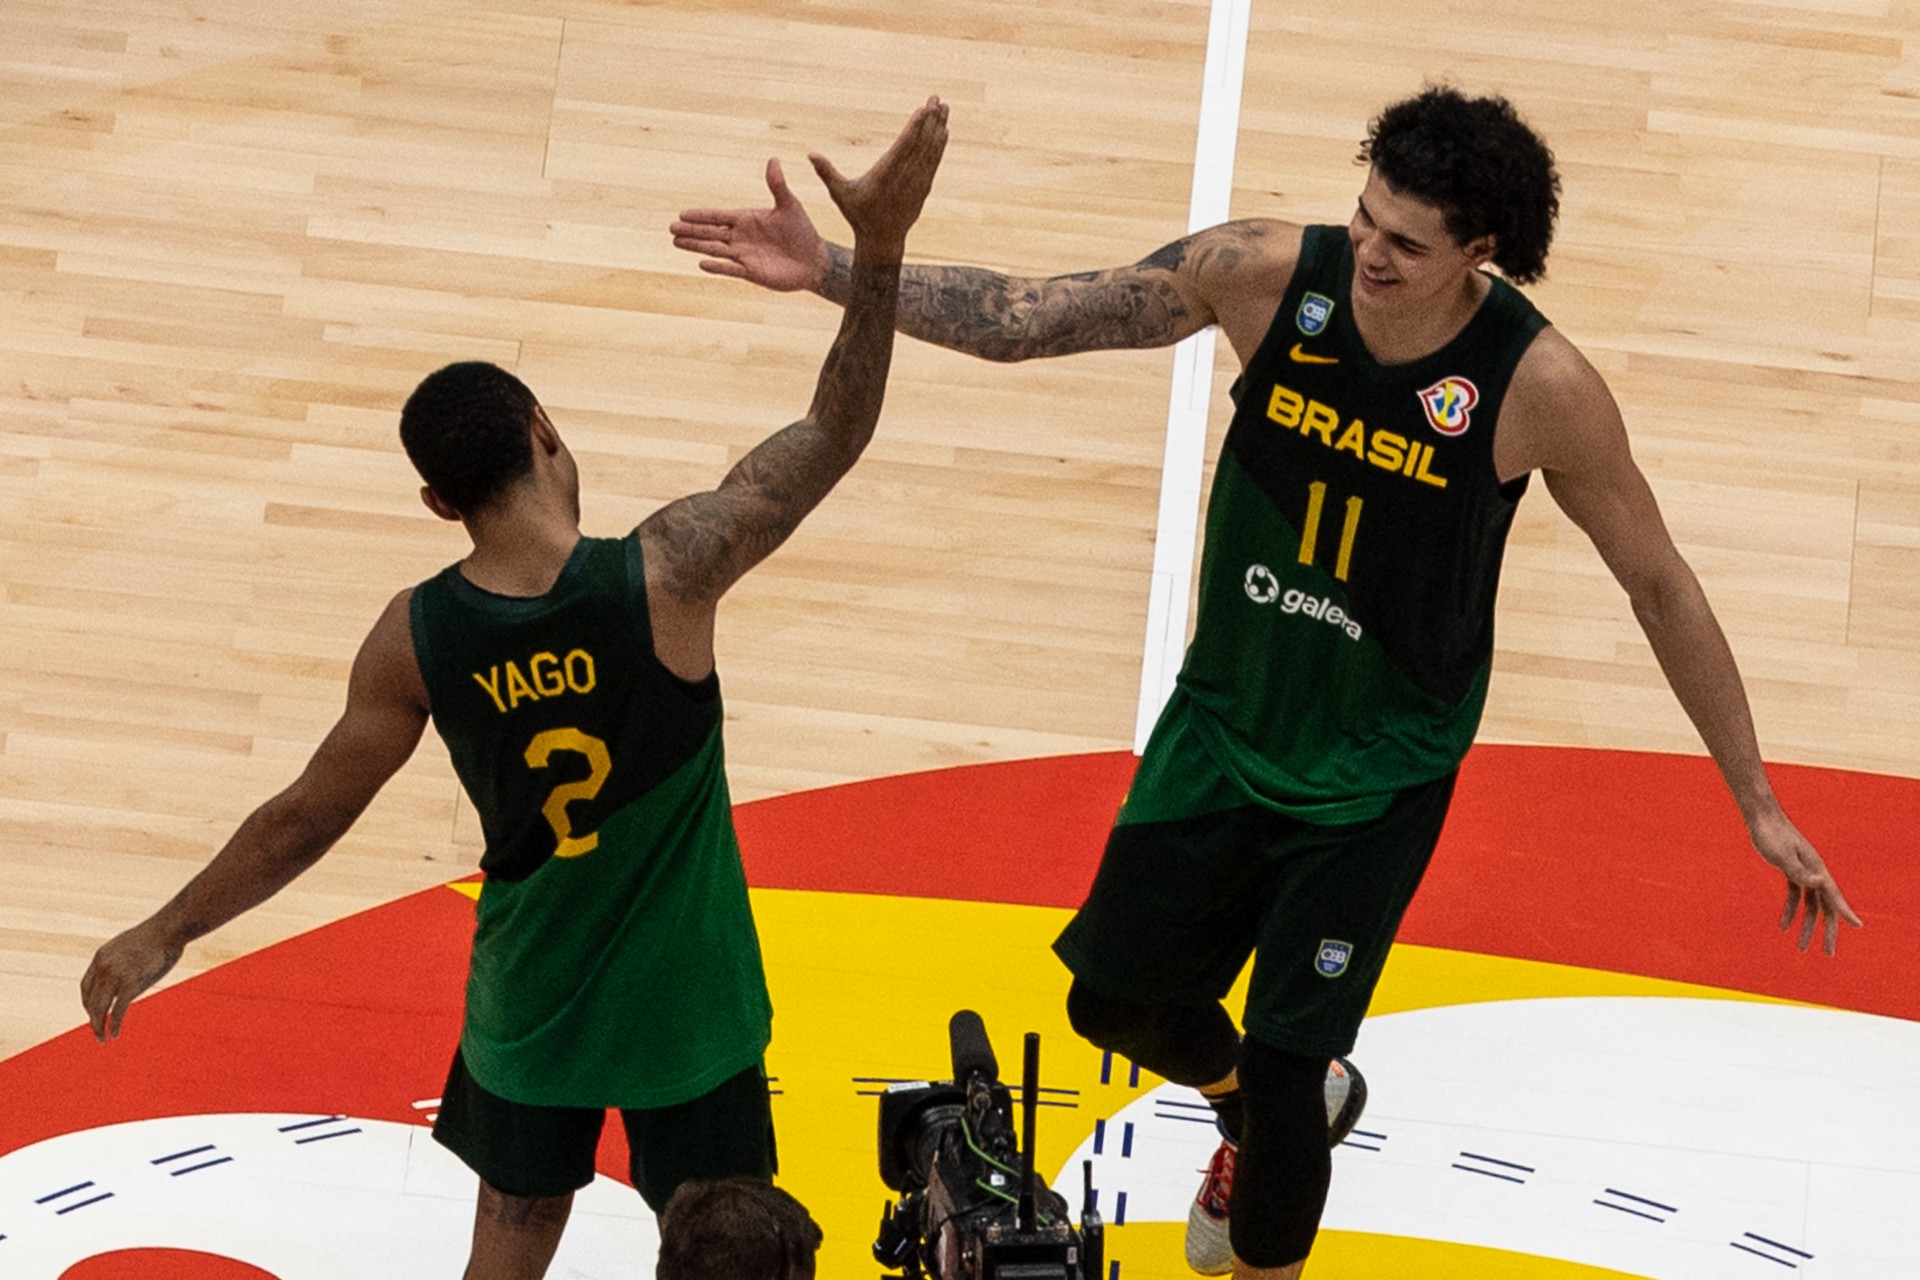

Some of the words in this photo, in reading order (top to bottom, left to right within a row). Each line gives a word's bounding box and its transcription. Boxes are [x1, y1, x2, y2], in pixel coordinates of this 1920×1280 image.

[1266, 383, 1447, 488] BRASIL
[1298, 480, 1363, 582] 11
[1280, 587, 1362, 641] galera
[472, 649, 596, 713] YAGO
[523, 727, 612, 858] 2
